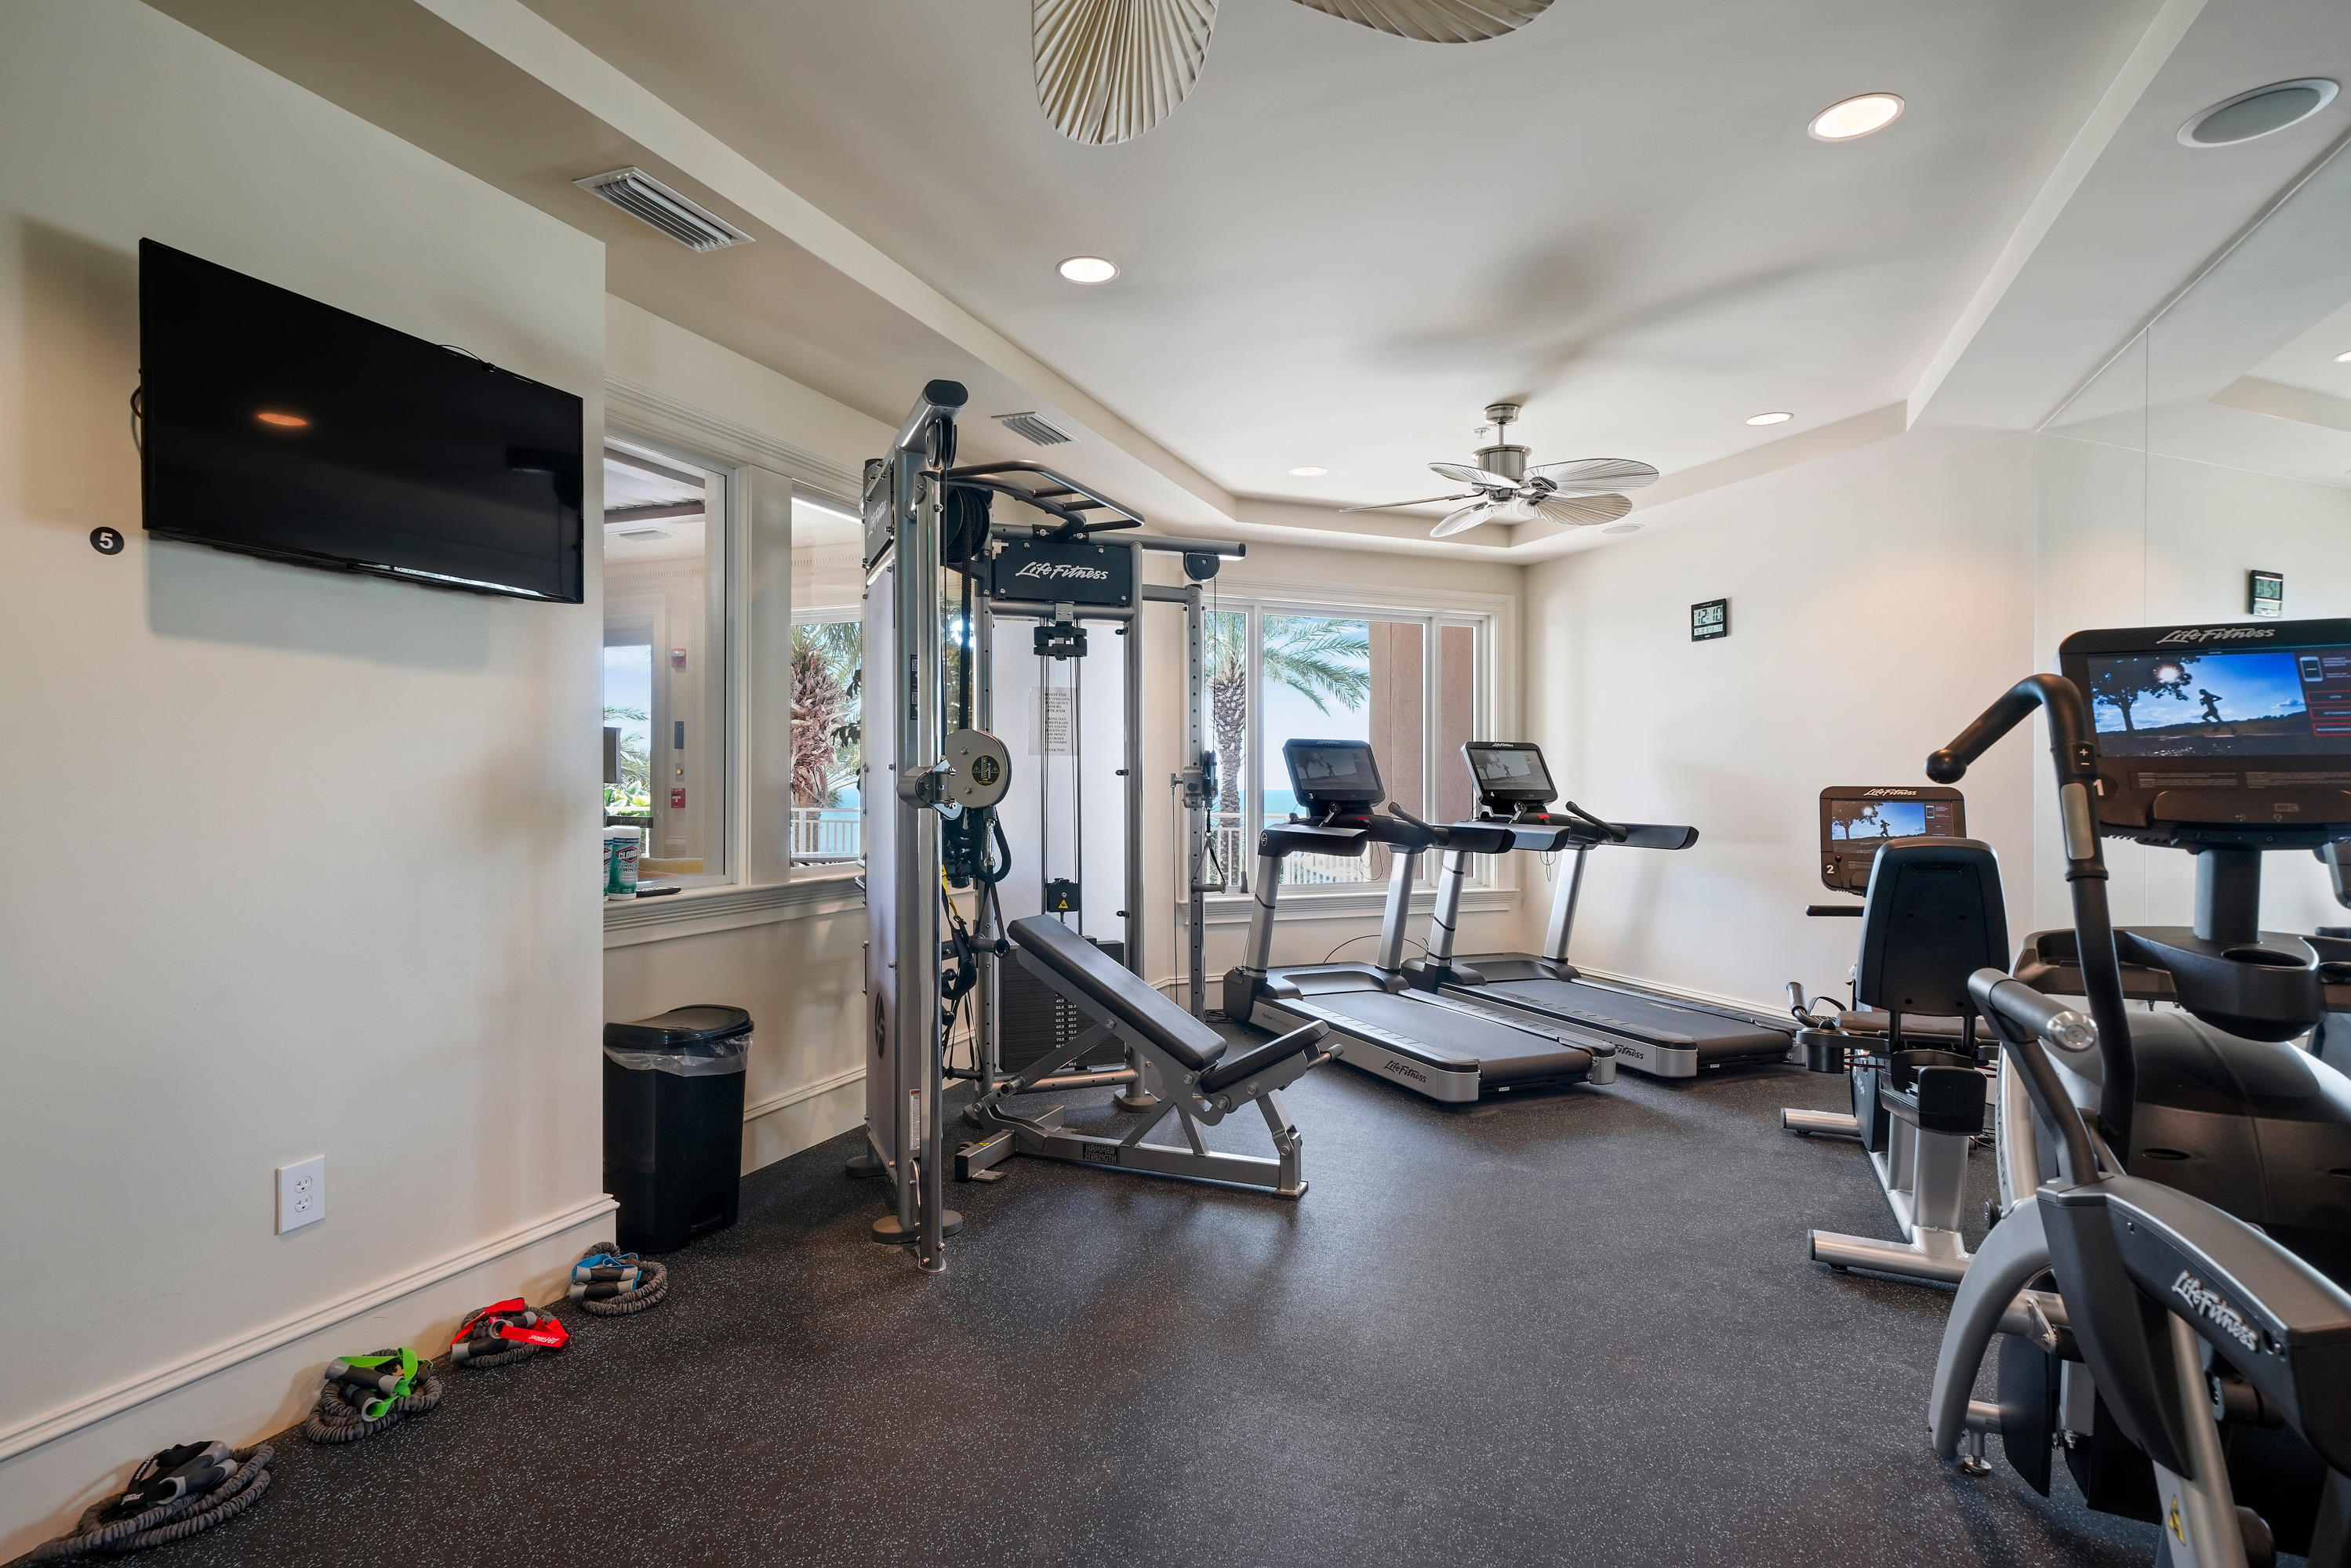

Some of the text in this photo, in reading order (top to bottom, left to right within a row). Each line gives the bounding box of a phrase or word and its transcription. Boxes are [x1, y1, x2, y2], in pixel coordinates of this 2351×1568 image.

[99, 532, 114, 550] 5
[1016, 561, 1109, 579] Life Fitness
[1698, 606, 1722, 624] 12:10
[2156, 627, 2276, 644] Life Fitness
[2092, 779, 2105, 797] 1
[1826, 865, 1834, 874] 2
[1383, 1060, 1427, 1083] Life Fitness
[1084, 1152, 1117, 1163] STRENGTH
[1085, 1144, 1116, 1155] HAMMER
[2171, 1269, 2259, 1352] Life Fitness
